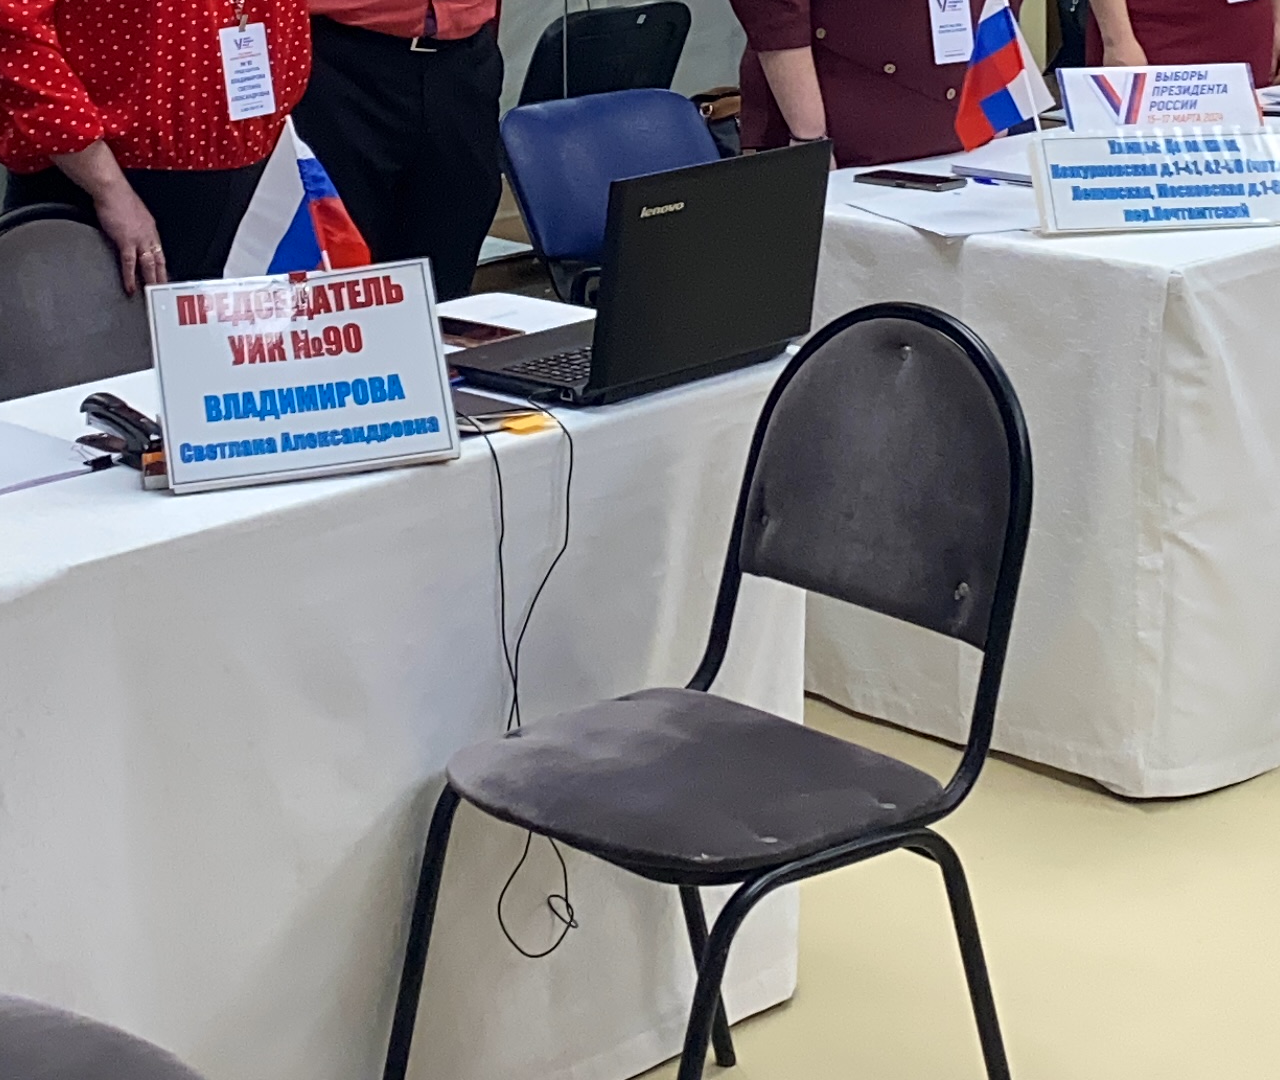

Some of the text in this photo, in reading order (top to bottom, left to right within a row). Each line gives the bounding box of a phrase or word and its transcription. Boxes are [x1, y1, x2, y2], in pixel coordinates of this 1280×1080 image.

[1151, 83, 1228, 97] ПРЕЗИДЕНТА
[1155, 69, 1208, 83] ВЫБОРЫ
[1149, 99, 1197, 112] РОССИИ
[640, 202, 685, 218] lenovo
[176, 275, 404, 326] ПРЕДСЕДАТЕЛЬ
[228, 322, 363, 365] УИК №90
[204, 373, 405, 423] ВЛАДИМИРОВА
[179, 414, 440, 464] Светлана Александровна
